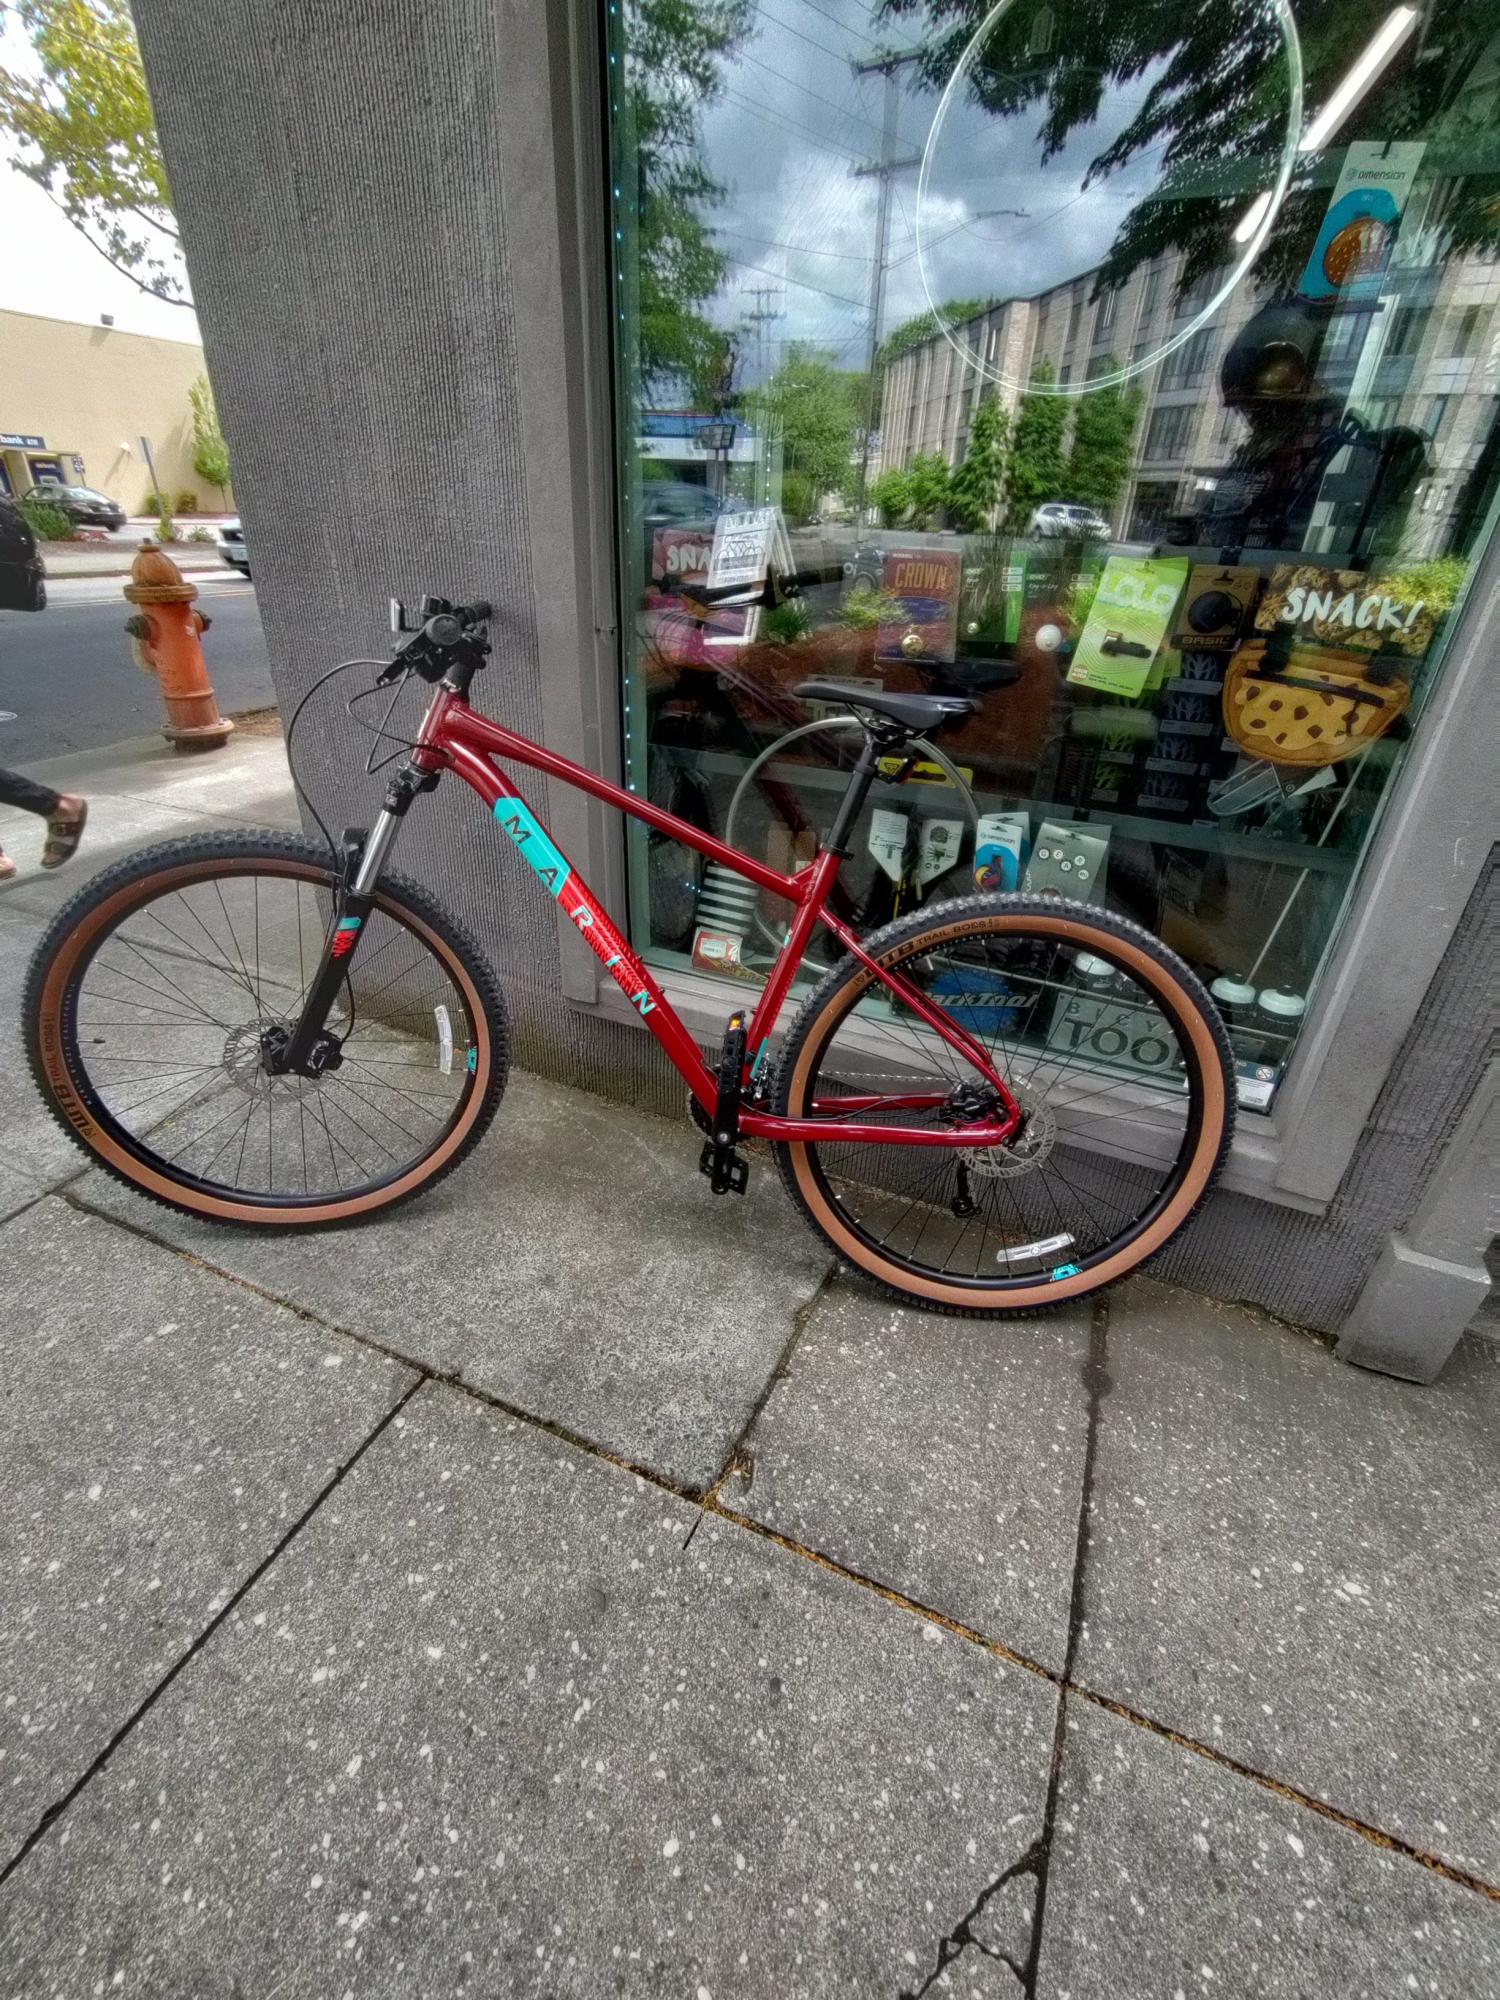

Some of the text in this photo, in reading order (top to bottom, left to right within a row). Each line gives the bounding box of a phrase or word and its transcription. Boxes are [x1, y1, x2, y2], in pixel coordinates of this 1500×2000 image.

[666, 543, 712, 572] SNA
[895, 561, 949, 591] CROWN
[1282, 586, 1425, 635] SNACK!
[504, 815, 656, 1016] MARIN
[916, 930, 949, 946] TRAIL
[47, 1056, 62, 1084] TRAIL
[54, 1083, 91, 1128] WTB
